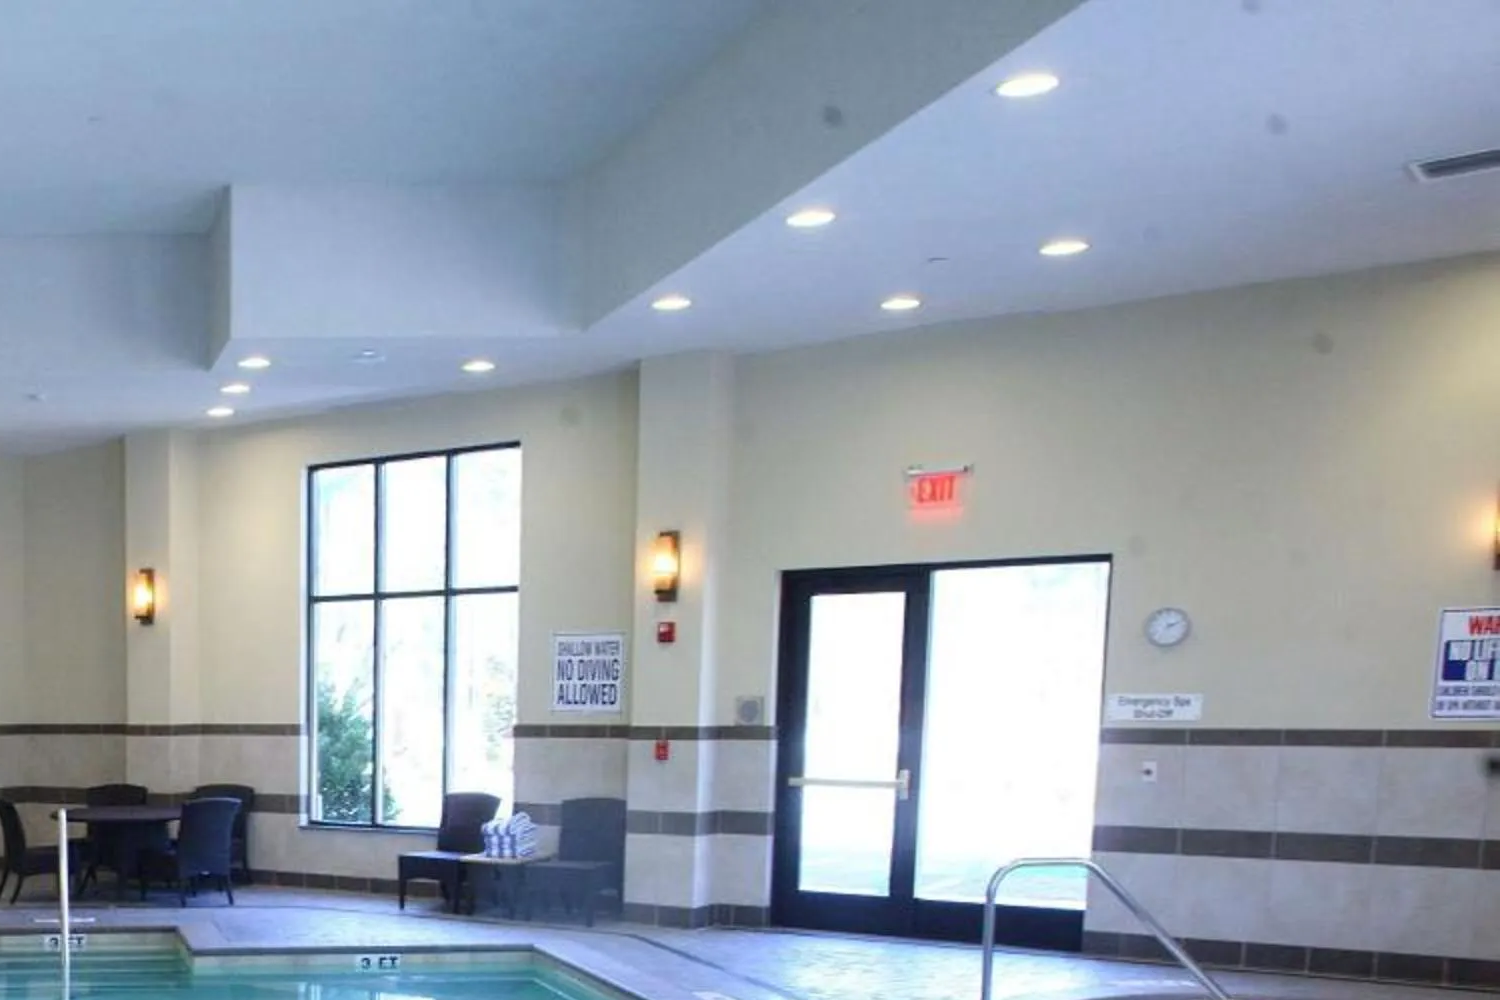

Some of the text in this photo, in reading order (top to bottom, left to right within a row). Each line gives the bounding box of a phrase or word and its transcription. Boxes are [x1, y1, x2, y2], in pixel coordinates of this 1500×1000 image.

[917, 475, 956, 503] EXIT
[557, 659, 620, 681] NO DIVING
[557, 683, 617, 705] ALLOWED
